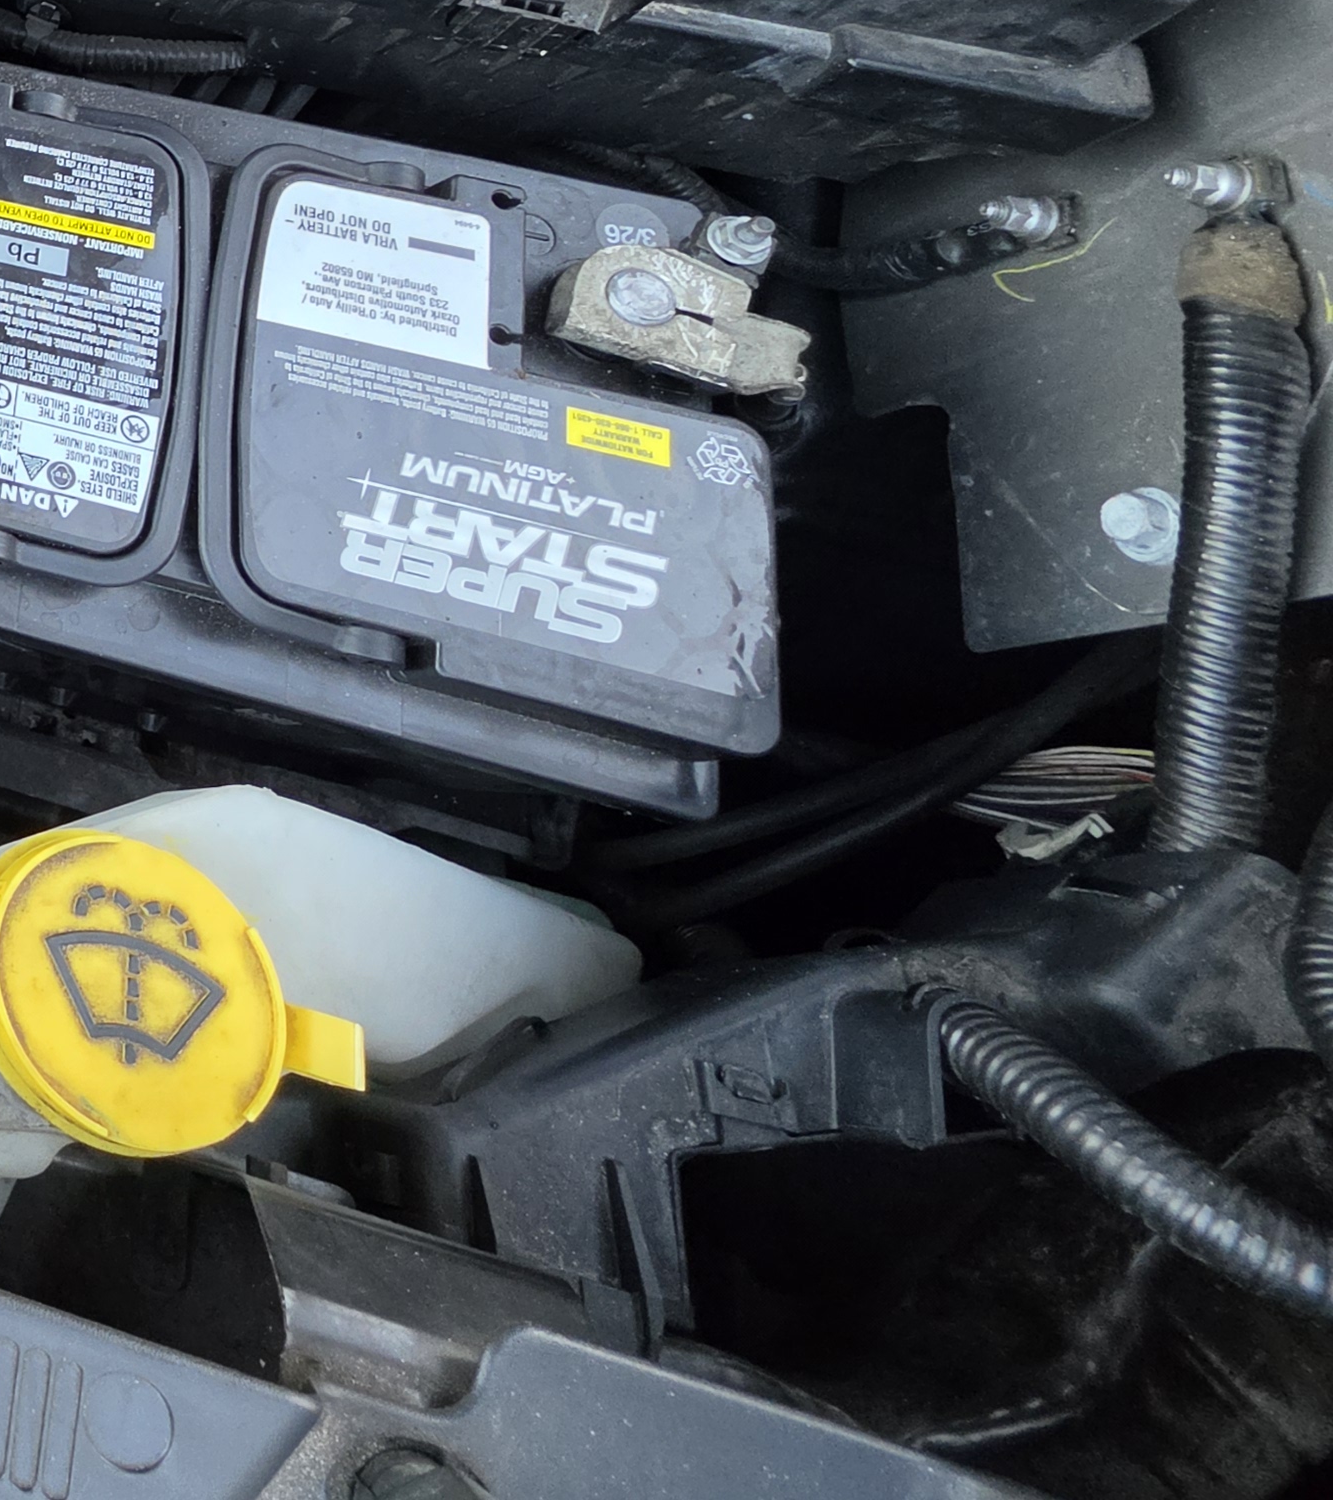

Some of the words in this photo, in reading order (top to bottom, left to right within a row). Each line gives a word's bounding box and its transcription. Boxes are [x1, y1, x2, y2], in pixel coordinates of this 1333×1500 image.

[24, 208, 49, 223] OPEN
[52, 215, 64, 226] TO
[293, 203, 334, 222] OPEN!
[339, 212, 367, 229] NOT
[67, 217, 111, 237] ATTEMPT
[114, 228, 134, 241] NOT
[296, 217, 357, 241] BATTERY
[371, 218, 390, 234] DO
[136, 232, 150, 245] DO
[360, 230, 398, 250] VRLA
[605, 224, 657, 248] 3/26
[6, 240, 40, 266] Pb
[83, 235, 143, 261] IMPORTANT
[321, 261, 353, 277] 65802
[355, 268, 373, 282] MO
[109, 280, 137, 297] HANDS
[139, 275, 164, 292] AFTER
[300, 279, 365, 305] Distributors,
[343, 278, 392, 298] Patterson
[376, 272, 438, 296] Springfield,
[138, 287, 162, 303] WASH
[308, 294, 332, 310] Auto
[394, 289, 426, 305] South
[428, 296, 449, 310] 233
[334, 298, 377, 320] O'Reilly
[367, 295, 428, 318] Automotive
[379, 308, 395, 324] by:
[430, 308, 460, 325] Ozark
[397, 314, 457, 337] Distributed
[7, 354, 26, 368] NOT
[26, 347, 60, 366] PROPER
[60, 355, 96, 374] FOLLOW
[1, 363, 48, 385] EXPLOSION
[77, 371, 91, 384] OR
[117, 369, 158, 389] DIVERTED
[71, 380, 83, 393] OF
[84, 383, 105, 398] RISK
[91, 374, 149, 398] DISASSEMBLE
[20, 390, 70, 412] CHILDREN.
[106, 389, 149, 409] WARNING:
[37, 405, 55, 420] THE
[57, 410, 70, 423] OF
[72, 402, 84, 415] OF
[86, 406, 118, 423] REACH
[72, 414, 91, 429] OUT
[94, 419, 117, 435] KEEP
[52, 432, 82, 450] INJURY.
[592, 427, 640, 445] WARRANTY
[641, 427, 662, 440] CALL
[83, 440, 95, 453] OR
[97, 443, 141, 464] BLINDNESS
[64, 448, 90, 465] CAUSE
[92, 455, 108, 469] CAN
[0, 461, 13, 476] NO
[110, 459, 139, 478] GASES
[503, 458, 566, 486] AGM
[76, 479, 102, 497] EYES.
[89, 468, 138, 492] EXPLOSIVE
[105, 486, 137, 506] SHIELD
[402, 451, 656, 535] PLATINUM
[337, 490, 669, 611] START
[340, 528, 622, 643] SUPER
